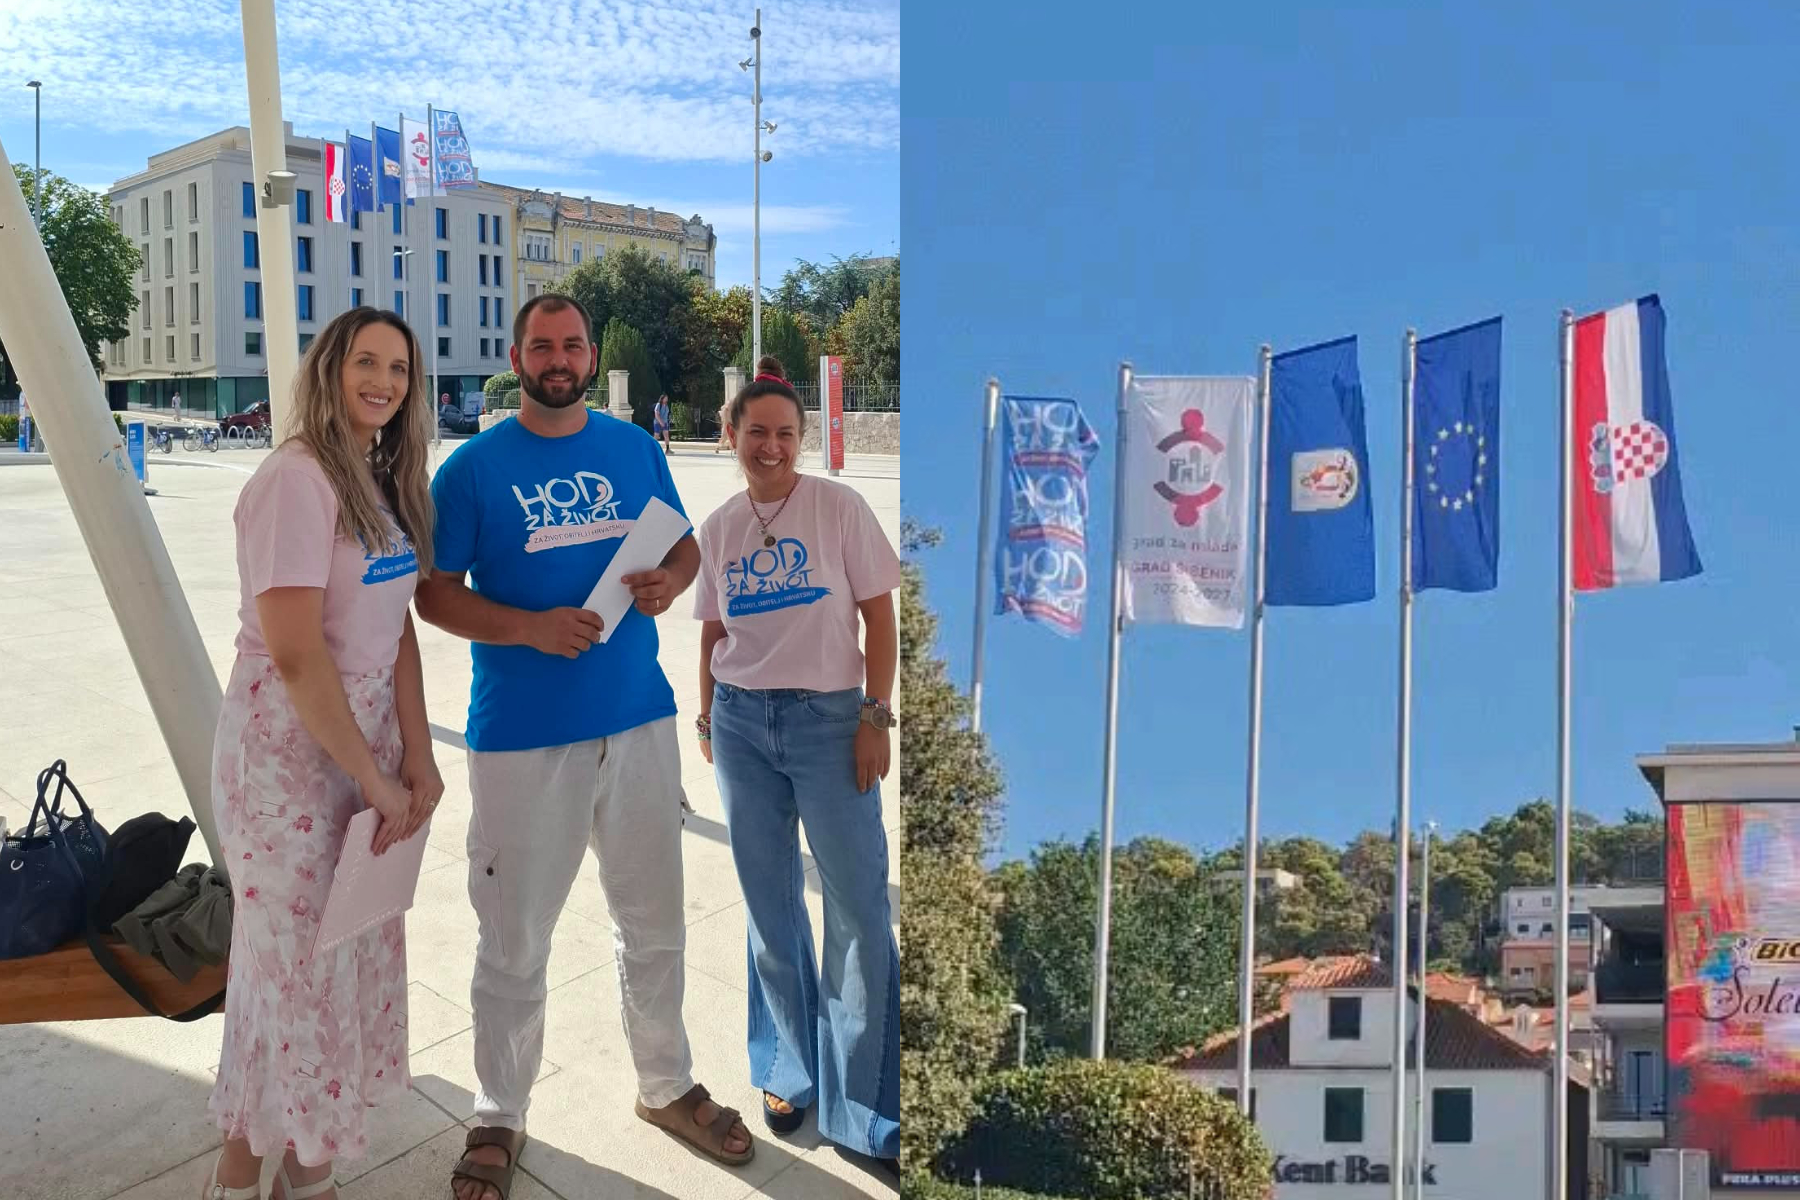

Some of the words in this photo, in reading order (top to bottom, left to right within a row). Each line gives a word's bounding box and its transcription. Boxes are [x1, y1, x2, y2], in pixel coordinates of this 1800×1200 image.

[437, 161, 473, 181] HOD
[512, 471, 613, 517] HOD
[524, 508, 558, 531] ZA
[561, 501, 621, 526] ŽIVOT
[728, 538, 808, 583] HOD
[1004, 547, 1087, 597] HOD
[1132, 562, 1171, 573] GRAD
[726, 578, 751, 597] ZA
[756, 569, 815, 595] ŽIVOT
